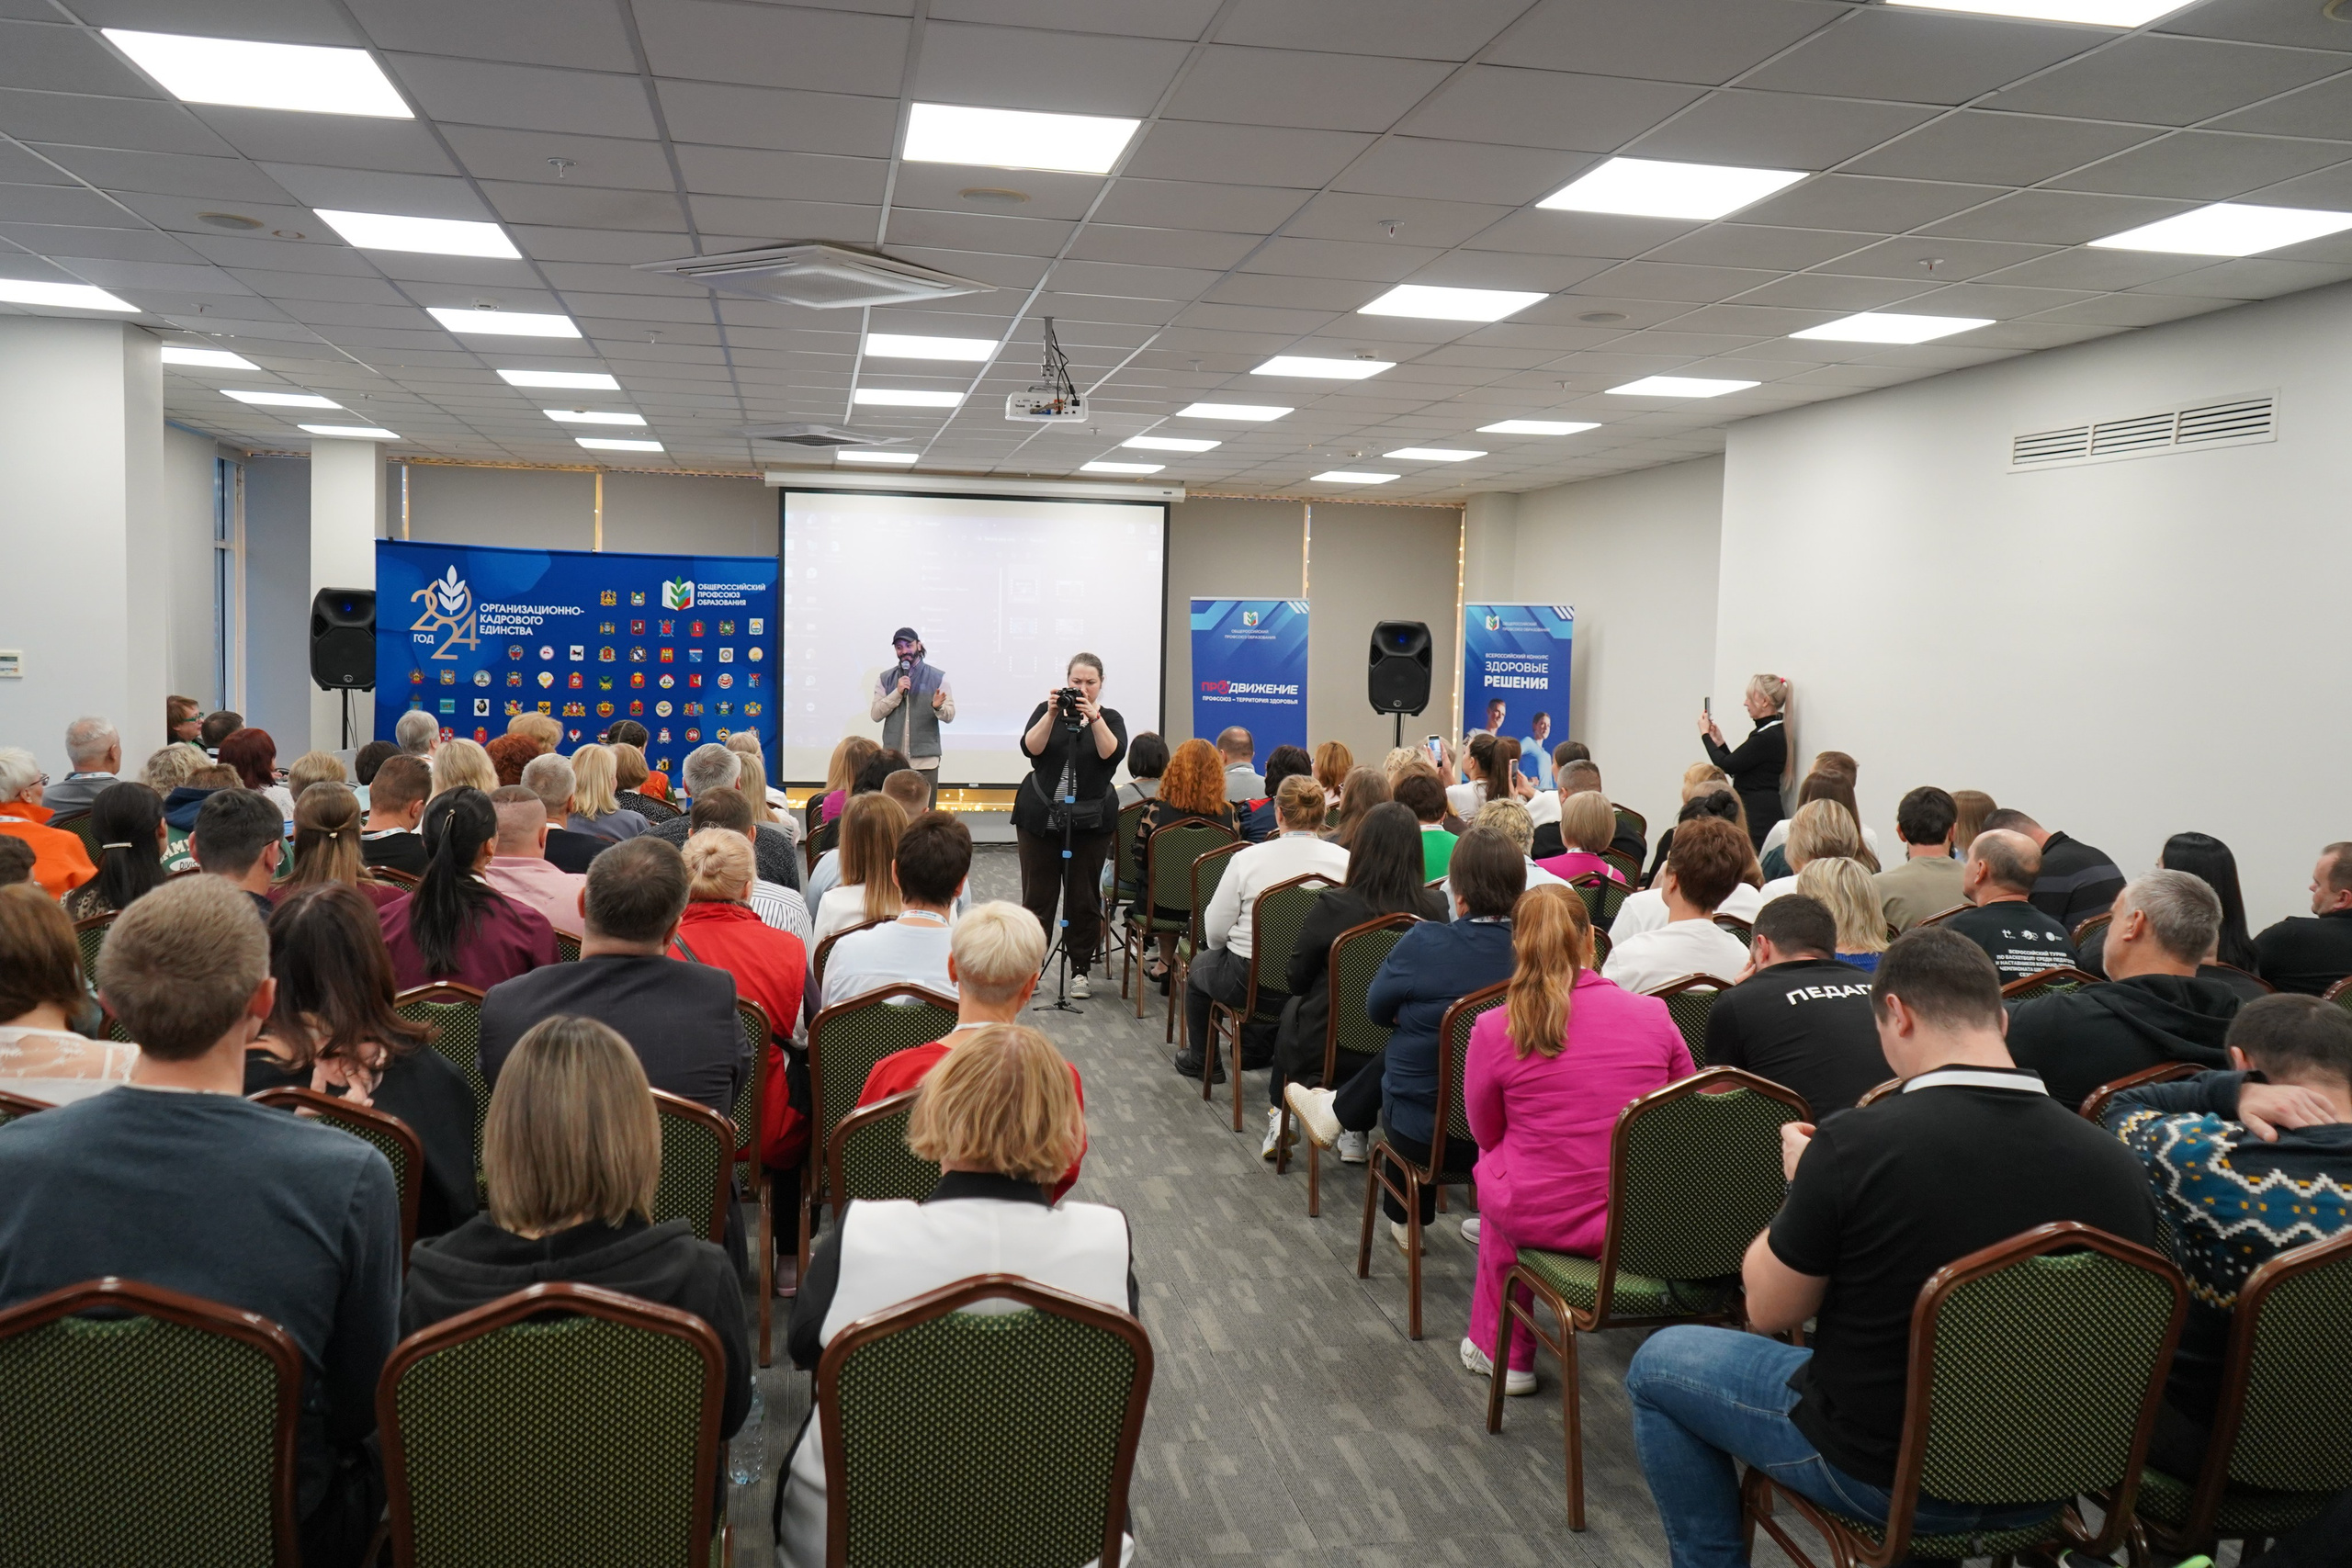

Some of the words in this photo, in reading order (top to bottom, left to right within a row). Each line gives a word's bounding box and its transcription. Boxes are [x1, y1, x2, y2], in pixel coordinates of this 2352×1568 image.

[480, 603, 585, 615] ОРГАНИЗАЦИОННО-
[480, 614, 544, 626] КАДРОВОГО
[480, 625, 534, 636] ЕДИНСТВА
[413, 634, 435, 645] ГОД
[1485, 660, 1549, 673] ЗДОРОВЫЕ
[1484, 675, 1549, 690] РЕШЕНИЯ
